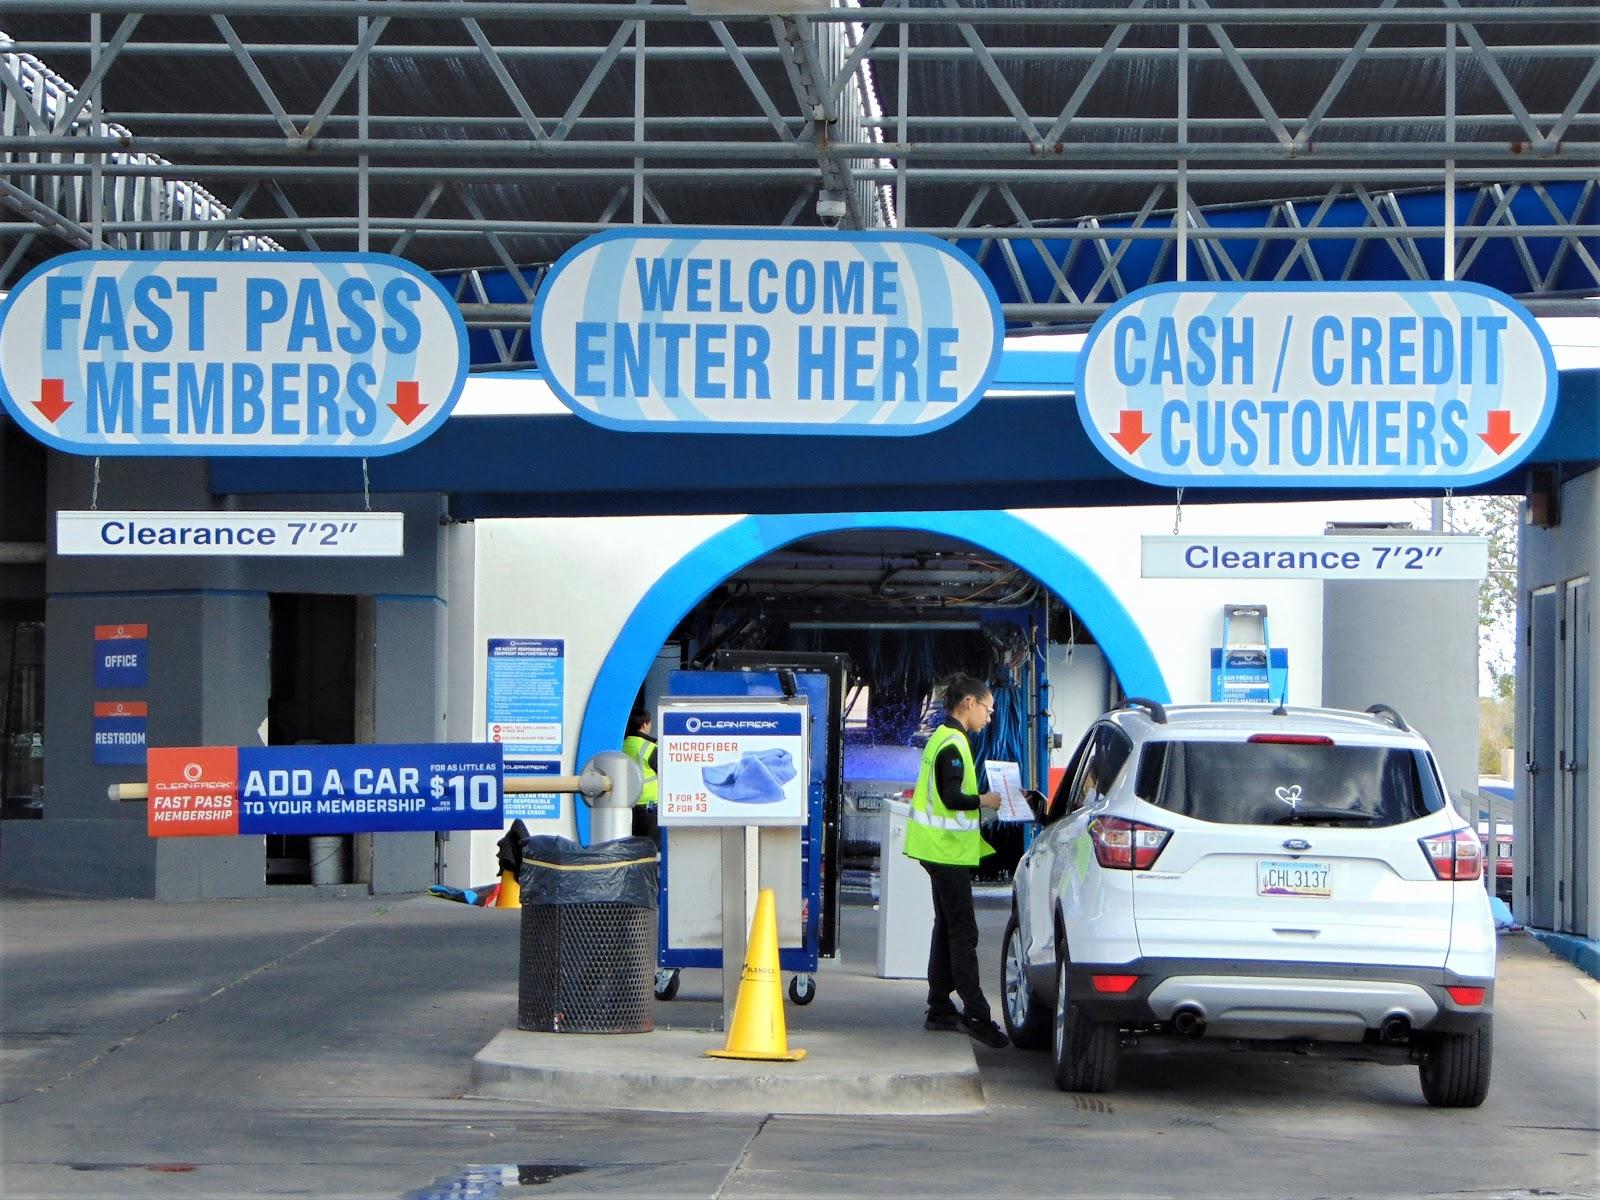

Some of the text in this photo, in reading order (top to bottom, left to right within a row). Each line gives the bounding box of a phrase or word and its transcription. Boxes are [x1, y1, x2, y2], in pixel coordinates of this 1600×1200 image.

[636, 258, 898, 315] WELCOME
[46, 276, 422, 354] FAST PASS
[575, 322, 959, 402] ENTER HERE
[1114, 315, 1508, 393] CASH / CREDIT
[86, 361, 377, 437] MEMBERS
[1160, 399, 1469, 467] CUSTOMERS
[101, 521, 276, 546] Clearance
[1185, 545, 1360, 570] Clearance
[105, 654, 137, 668] OFFICE
[95, 732, 146, 745] RESTROOM
[669, 742, 738, 752] MICROFIBER
[669, 753, 714, 762] TOWELS
[430, 764, 445, 772] FOR
[485, 763, 496, 771] AS
[243, 768, 419, 797] ADD A CAR
[154, 796, 233, 808] FAST PASS
[430, 775, 497, 811] $10
[695, 793, 707, 801] $2
[155, 810, 233, 822] MEMBERSHIP
[244, 799, 426, 815] TO YOUR MEMBERSHIP
[668, 804, 674, 812] 2
[696, 804, 707, 812] $3
[1269, 869, 1328, 888] CHL3137
